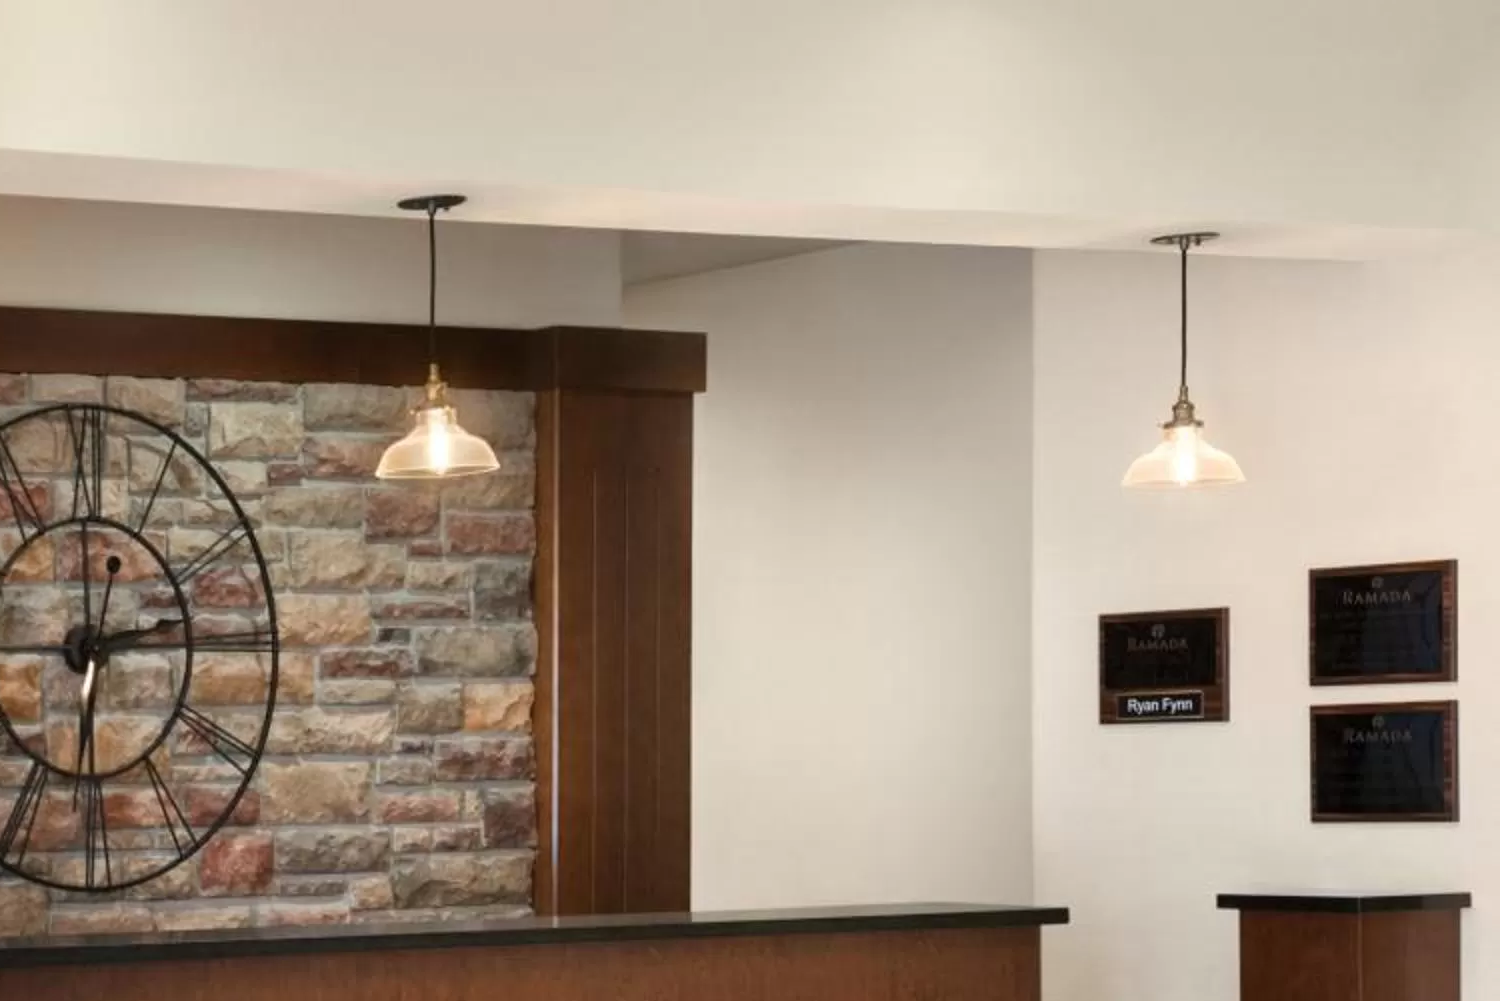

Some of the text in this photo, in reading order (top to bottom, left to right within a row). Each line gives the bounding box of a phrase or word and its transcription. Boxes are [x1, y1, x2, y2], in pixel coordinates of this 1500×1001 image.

[1342, 589, 1412, 606] RAMADA
[1126, 637, 1189, 652] RAMADA
[1127, 697, 1193, 714] Ryan Fynn
[1342, 726, 1413, 743] RAMADA
